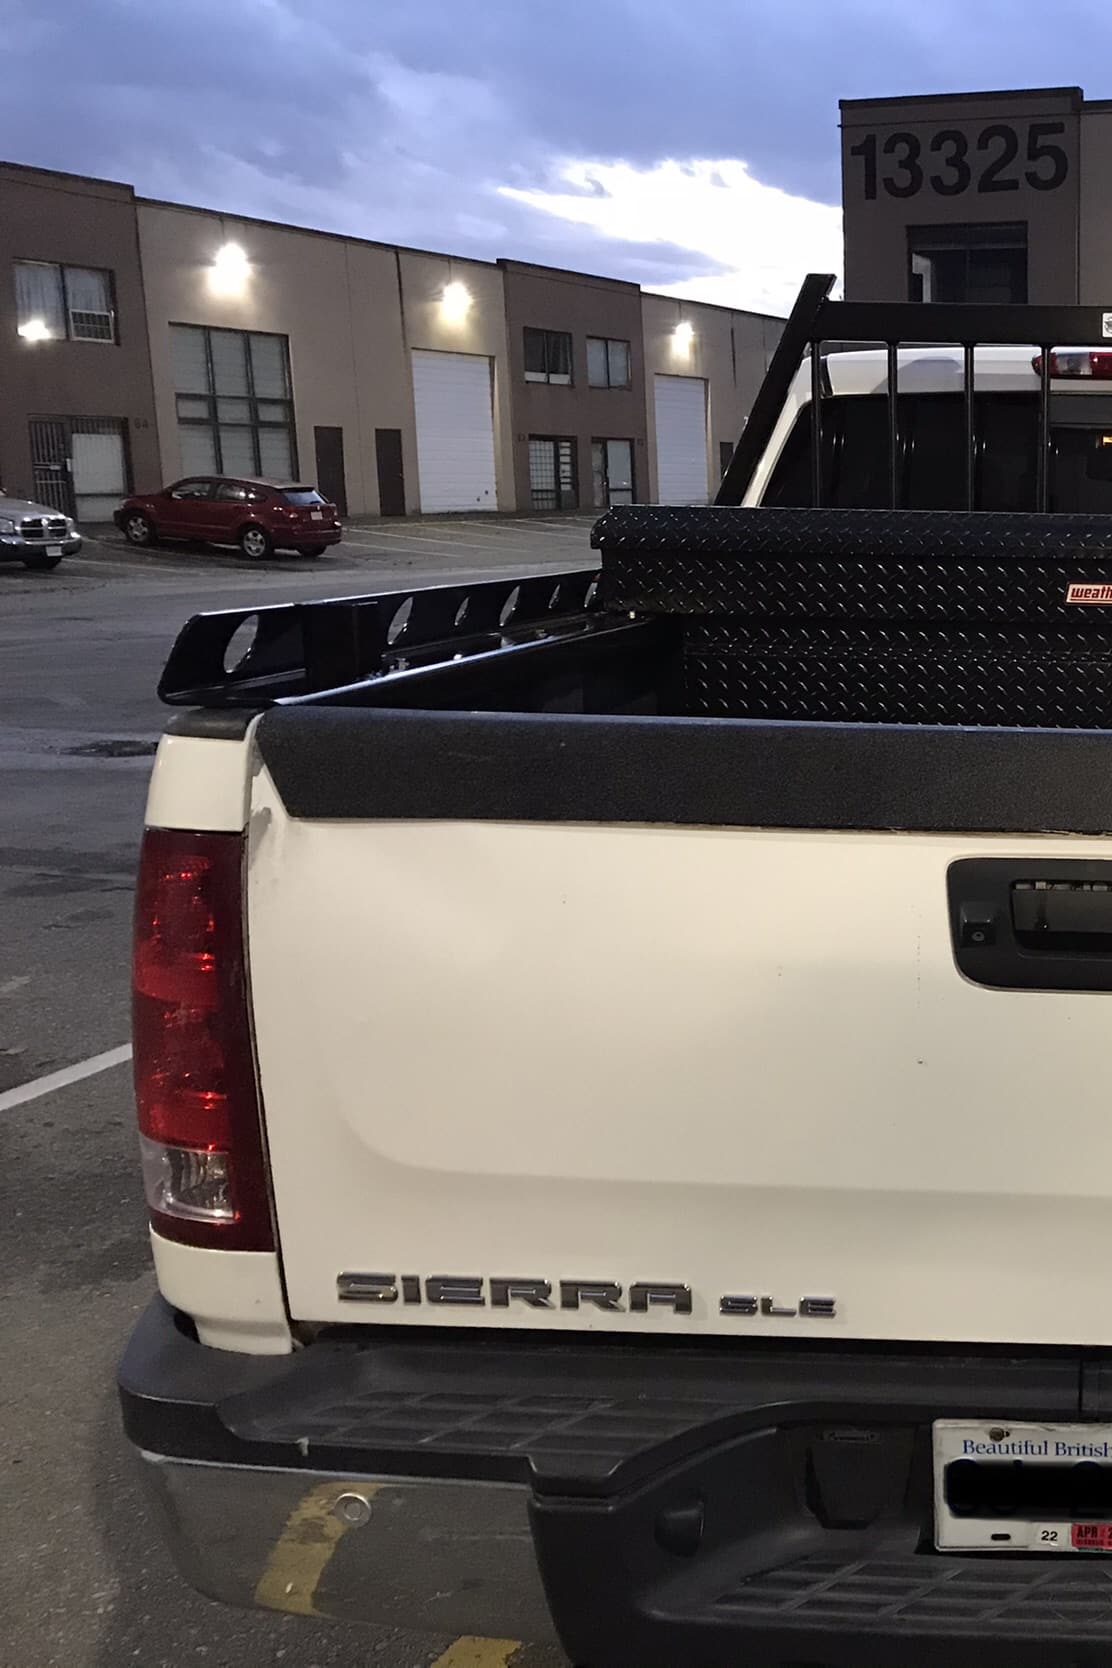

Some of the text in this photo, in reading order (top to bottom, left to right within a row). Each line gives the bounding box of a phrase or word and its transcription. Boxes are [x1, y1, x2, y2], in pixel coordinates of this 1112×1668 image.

[850, 122, 1069, 200] 13325
[336, 1271, 837, 1317] SIERRA SLE
[962, 1439, 1048, 1456] Beautiful
[1041, 1530, 1058, 1541] 22
[1076, 1525, 1099, 1539] APR
